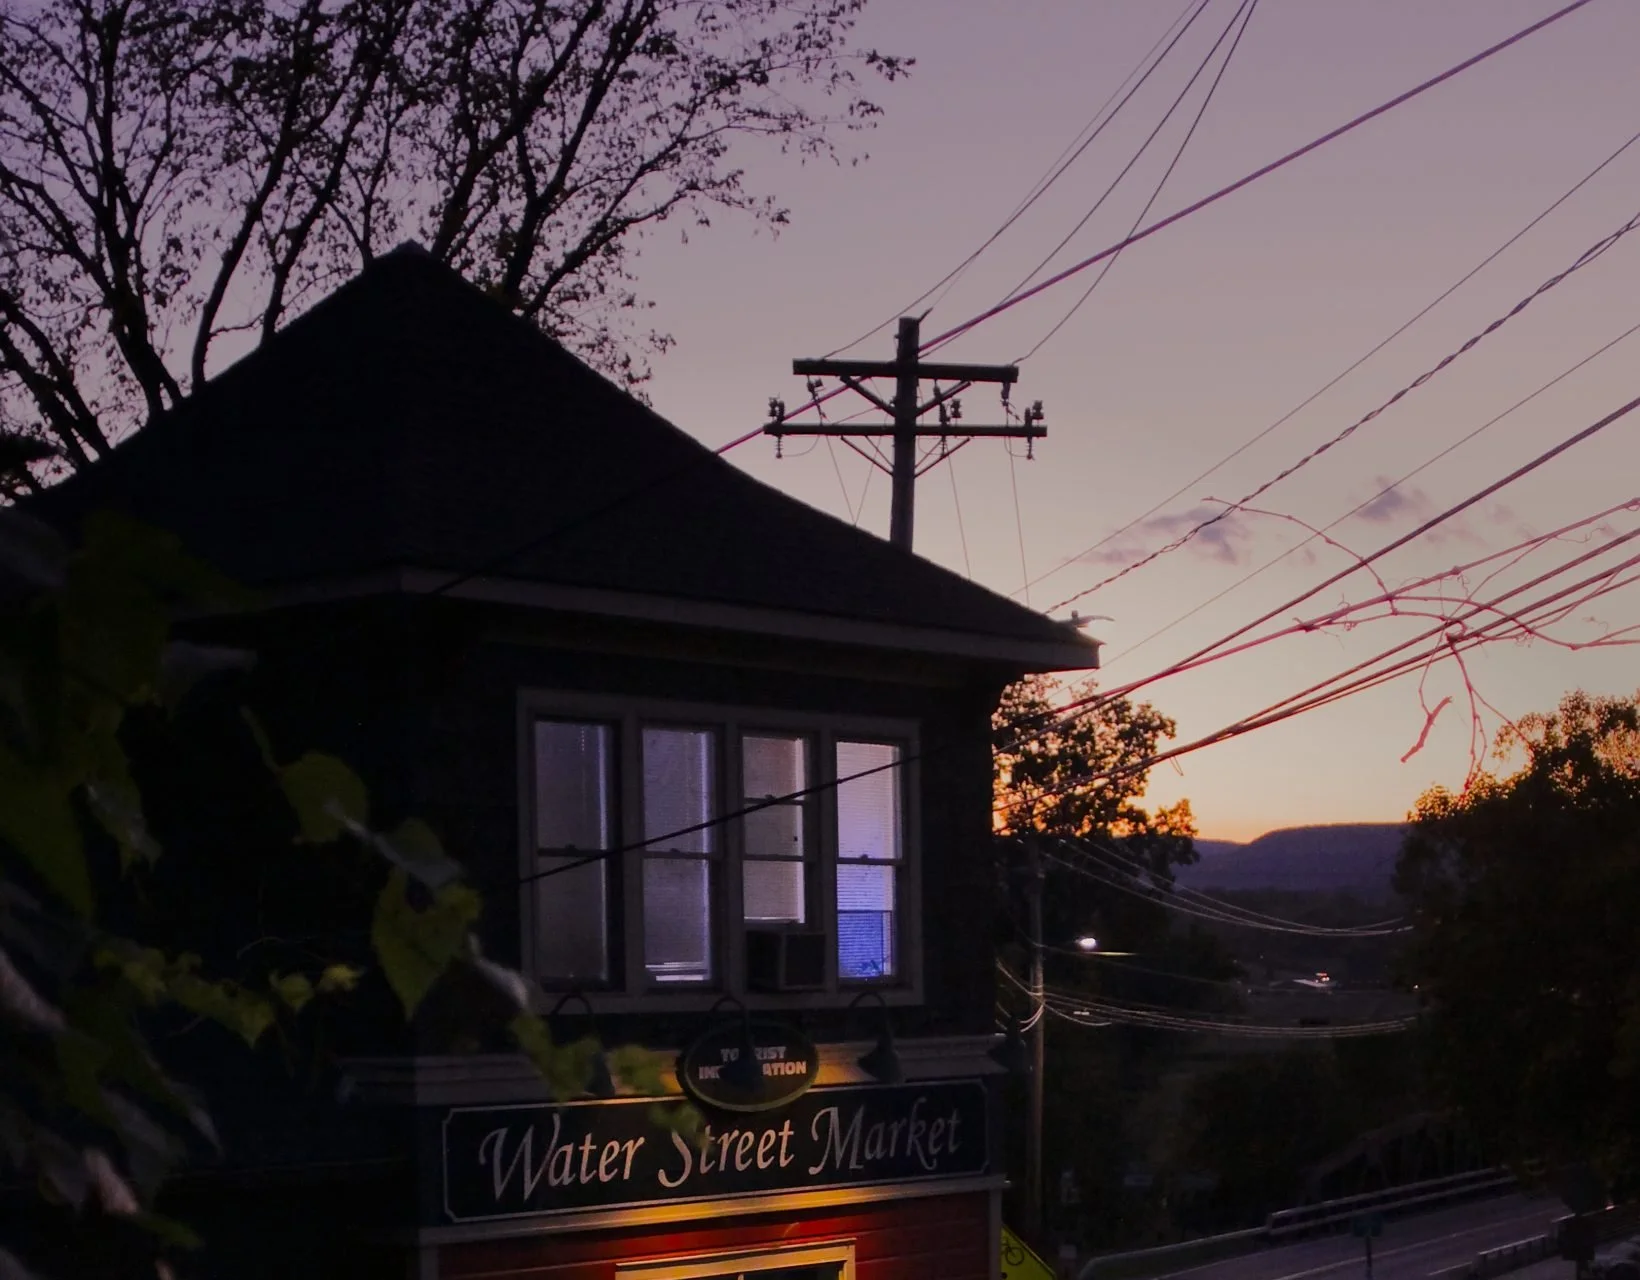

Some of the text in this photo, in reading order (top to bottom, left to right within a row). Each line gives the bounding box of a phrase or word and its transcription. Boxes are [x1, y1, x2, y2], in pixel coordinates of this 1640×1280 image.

[720, 1046, 787, 1063] TORIST
[699, 1061, 807, 1080] INFATION
[479, 1112, 645, 1203] Water
[808, 1096, 962, 1175] Market
